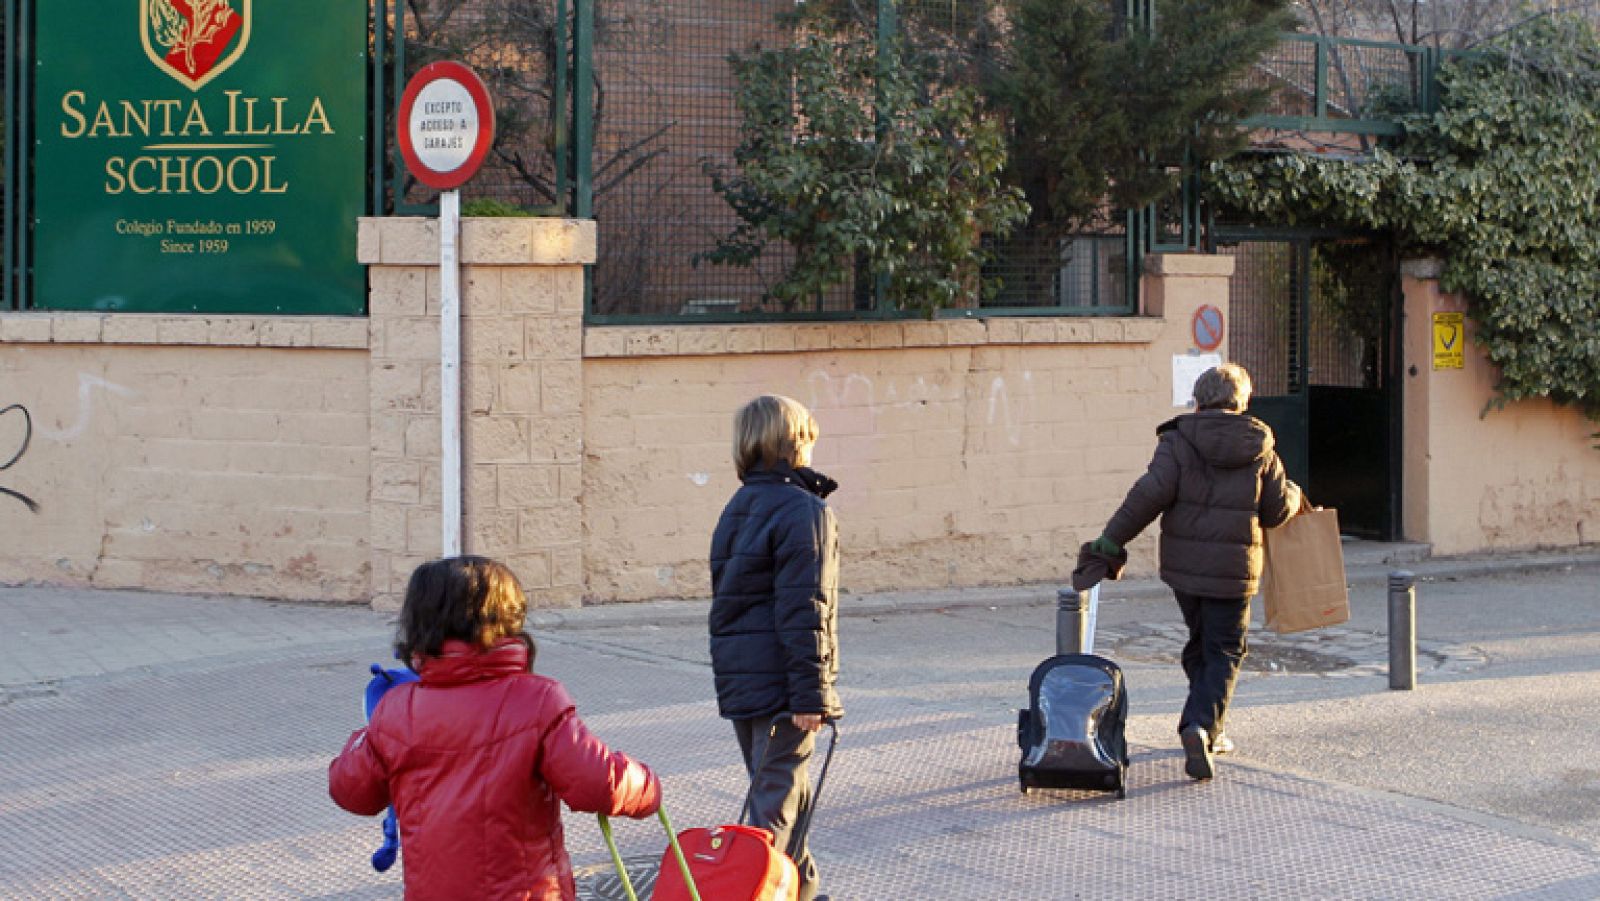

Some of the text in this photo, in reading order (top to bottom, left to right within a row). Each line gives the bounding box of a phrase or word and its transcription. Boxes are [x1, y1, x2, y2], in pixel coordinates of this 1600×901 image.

[60, 90, 336, 138] SANTA ILLA
[424, 101, 464, 115] EXCEPTO
[420, 118, 468, 131] ACCESO A
[424, 137, 463, 149] GARAJES
[104, 155, 289, 194] SCHOOL
[115, 219, 277, 237] Colegio Fundado en 1959
[160, 239, 229, 254] Since 1959
